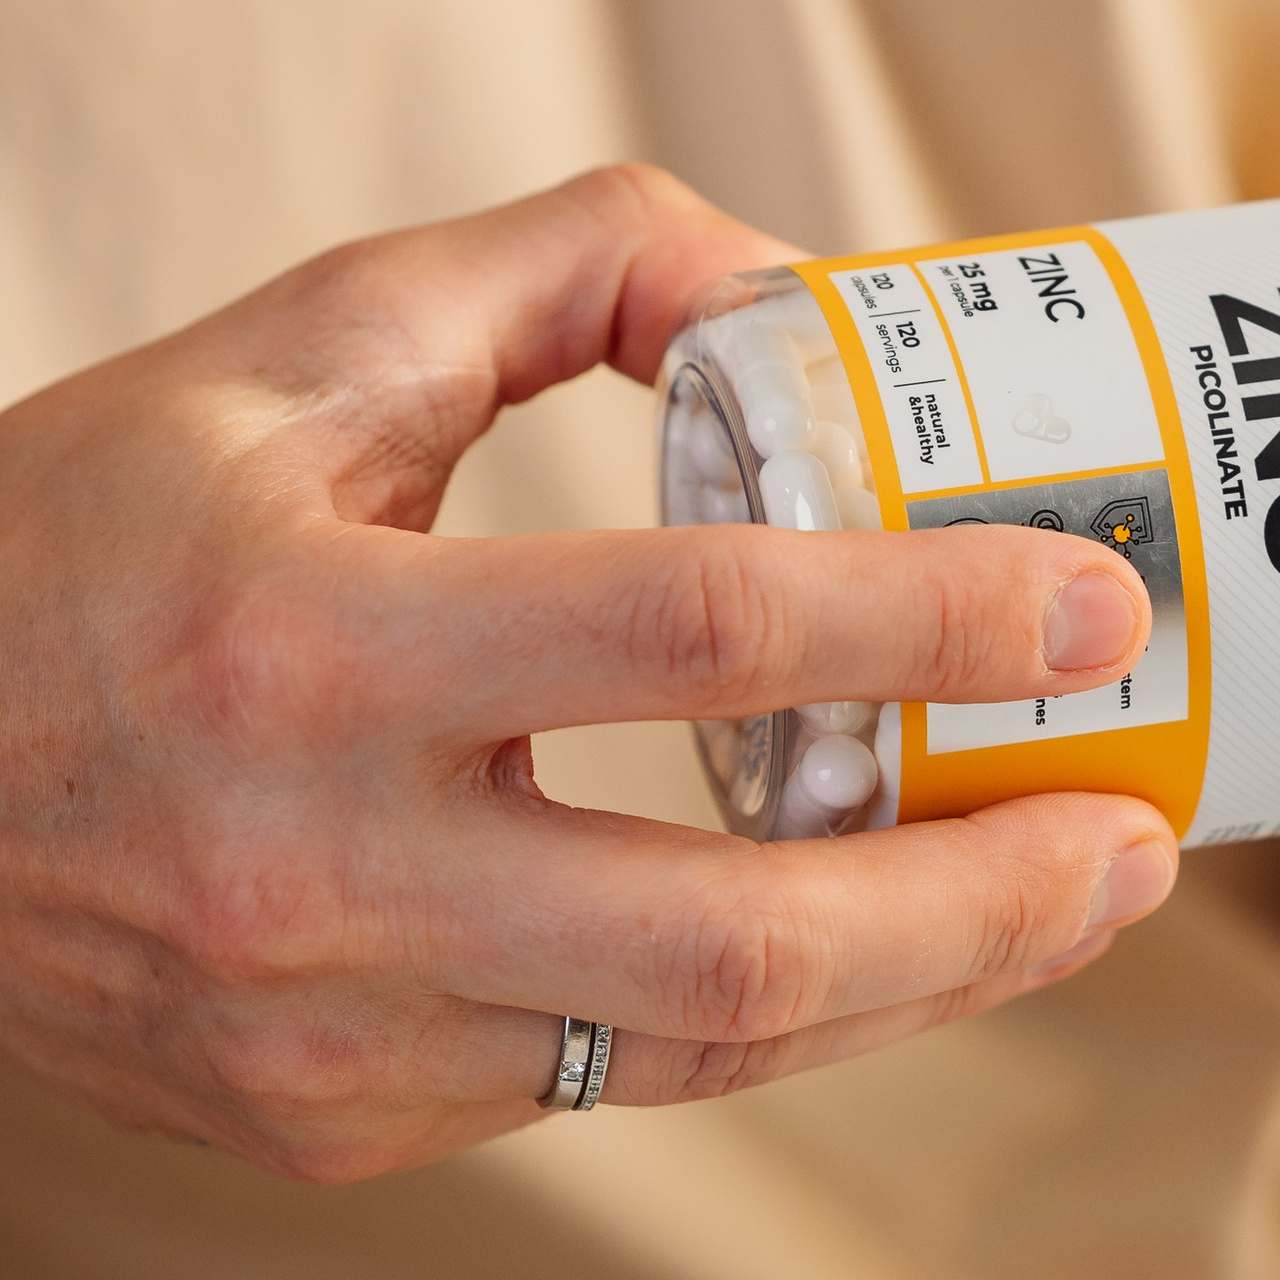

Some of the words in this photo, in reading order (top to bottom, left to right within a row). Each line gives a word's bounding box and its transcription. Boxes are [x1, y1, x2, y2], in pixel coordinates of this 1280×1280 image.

[870, 273, 893, 290] 120
[958, 263, 985, 278] 25
[1017, 253, 1085, 323] ZINC
[850, 275, 877, 309] capsules
[950, 281, 974, 318] capsule
[971, 282, 998, 312] mg
[876, 324, 902, 373] servings
[896, 321, 920, 348] 120
[908, 396, 934, 465] &healthy
[925, 394, 950, 448] natural
[1189, 345, 1248, 520] PICOLINATE
